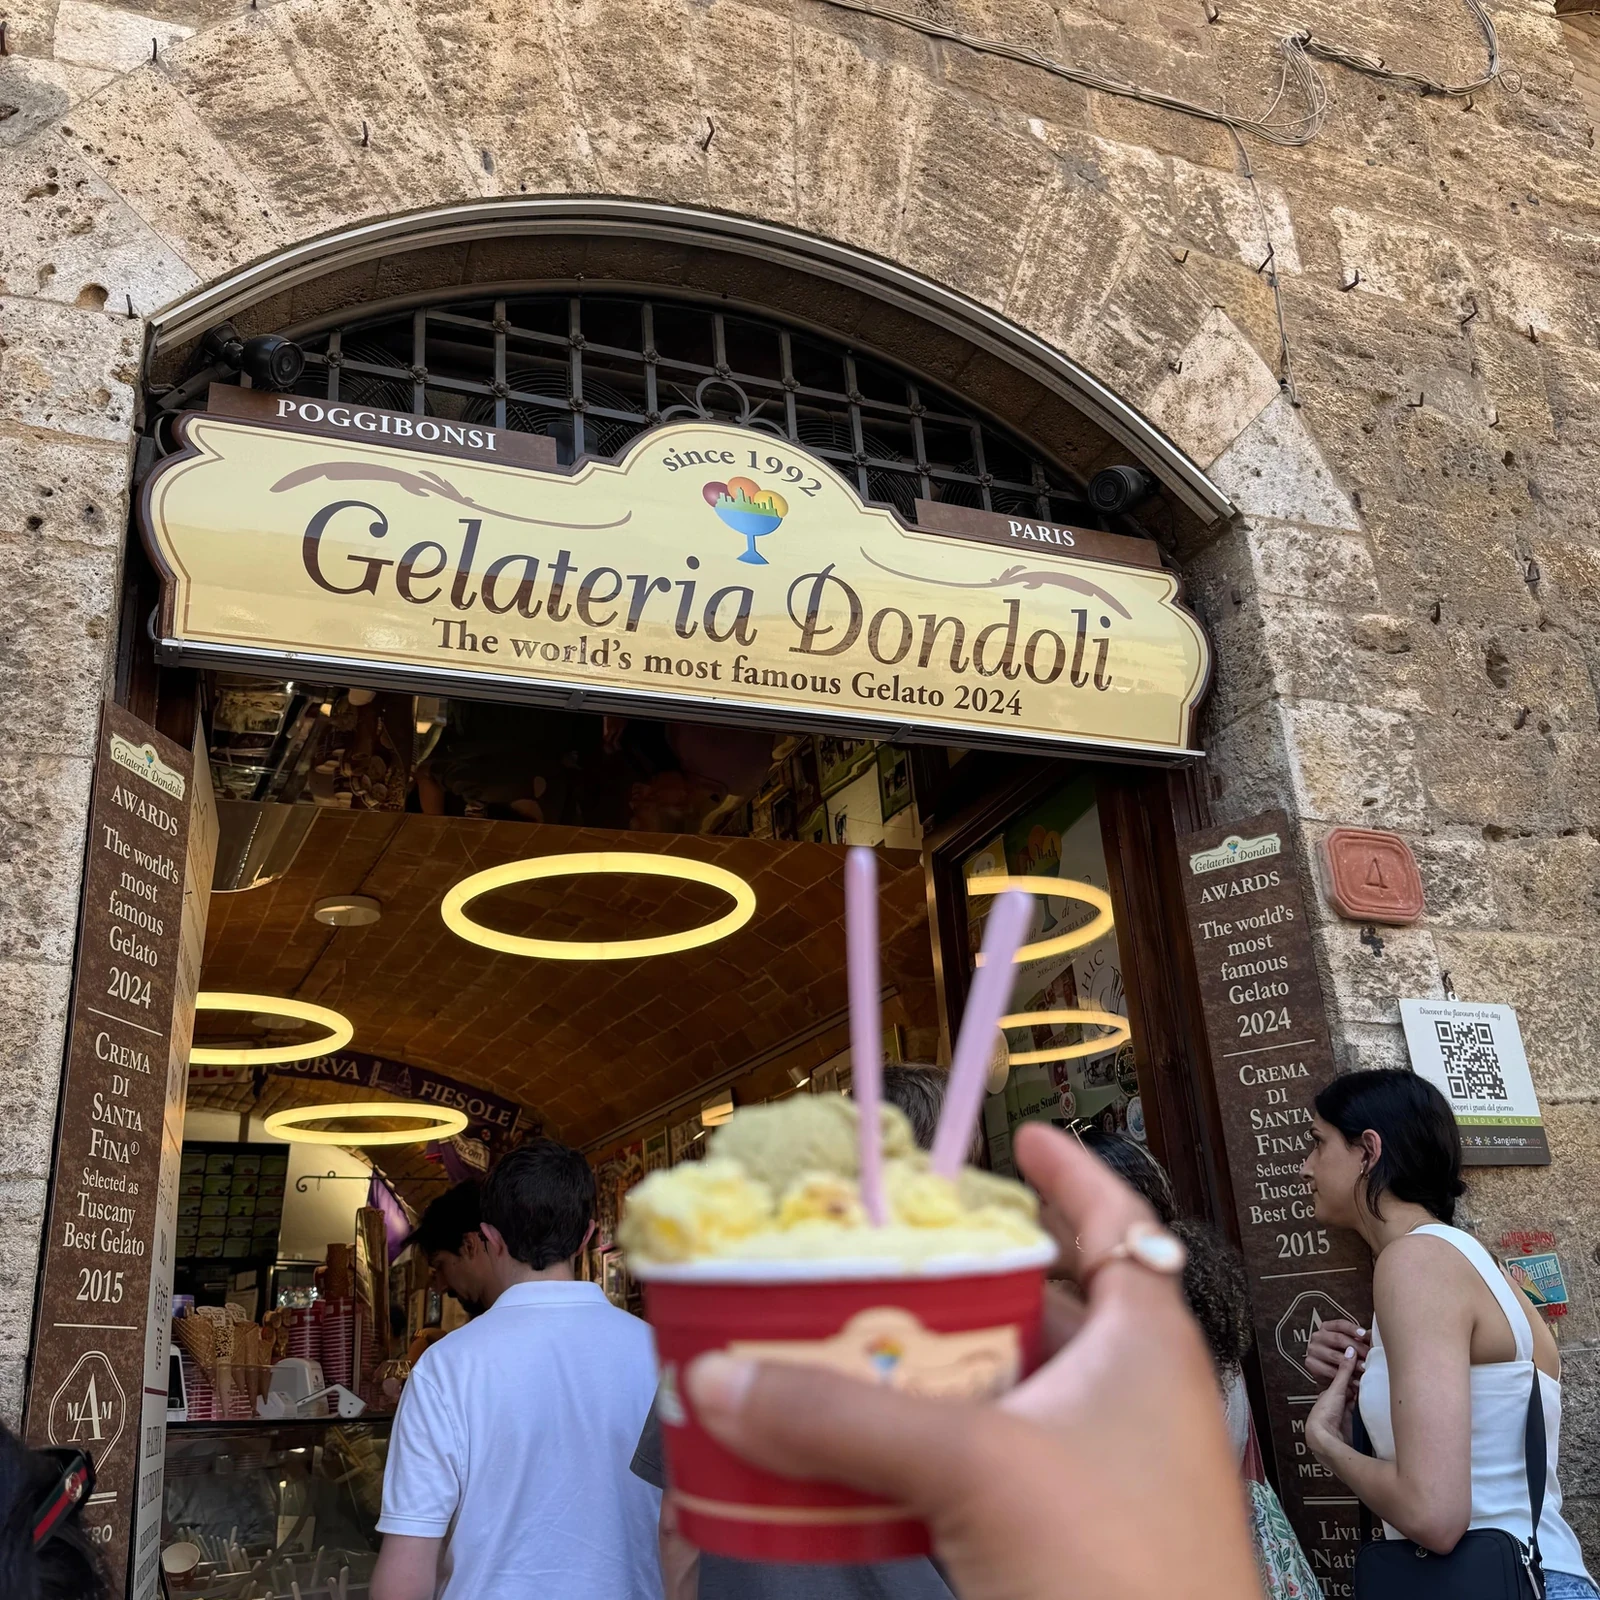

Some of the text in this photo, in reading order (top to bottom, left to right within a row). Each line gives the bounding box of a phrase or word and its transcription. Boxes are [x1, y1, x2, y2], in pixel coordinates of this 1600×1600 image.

[276, 399, 496, 450] POGGIBONSI
[662, 447, 822, 497] since 1992
[1008, 521, 1076, 547] PARIS
[302, 500, 1114, 692] Gelateria Dondoli
[432, 617, 1022, 716] The world's most famous Gelato 2024
[113, 747, 182, 797] Gelateria Dondoli
[111, 785, 178, 836] AWARDS
[103, 824, 179, 885] The world's
[1195, 843, 1277, 872] Gelateria Dondoli
[120, 871, 158, 903] most
[1200, 870, 1280, 904] AWARDS
[108, 890, 164, 936] famous
[1198, 905, 1294, 940] The world's
[109, 925, 158, 967] Gelato
[1227, 933, 1274, 957] most
[1221, 955, 1289, 981] famous
[107, 966, 151, 1009] 2024
[1228, 981, 1289, 1005] Gelato
[1237, 1006, 1292, 1037] 2024
[1419, 1006, 1443, 1016] Discover
[1443, 1009, 1452, 1017] the
[1475, 1010, 1481, 1020] of
[1490, 1012, 1501, 1021] day
[111, 1074, 130, 1097] DI
[1266, 1087, 1288, 1105] DI
[418, 1080, 512, 1127] FIESOLE
[1018, 1103, 1041, 1119] Acting
[1472, 1104, 1487, 1113] gusti
[1487, 1103, 1495, 1112] del
[1496, 1105, 1514, 1113] giorno
[1502, 1117, 1536, 1125] GELATO
[82, 1166, 139, 1195] Selected as
[77, 1191, 136, 1232] Tuscany
[1249, 1205, 1288, 1224] Best
[62, 1222, 97, 1251] Best
[101, 1227, 145, 1256] Gelato
[1276, 1229, 1330, 1258] 2015
[76, 1268, 124, 1303] 2015
[1318, 1520, 1383, 1541] Livig
